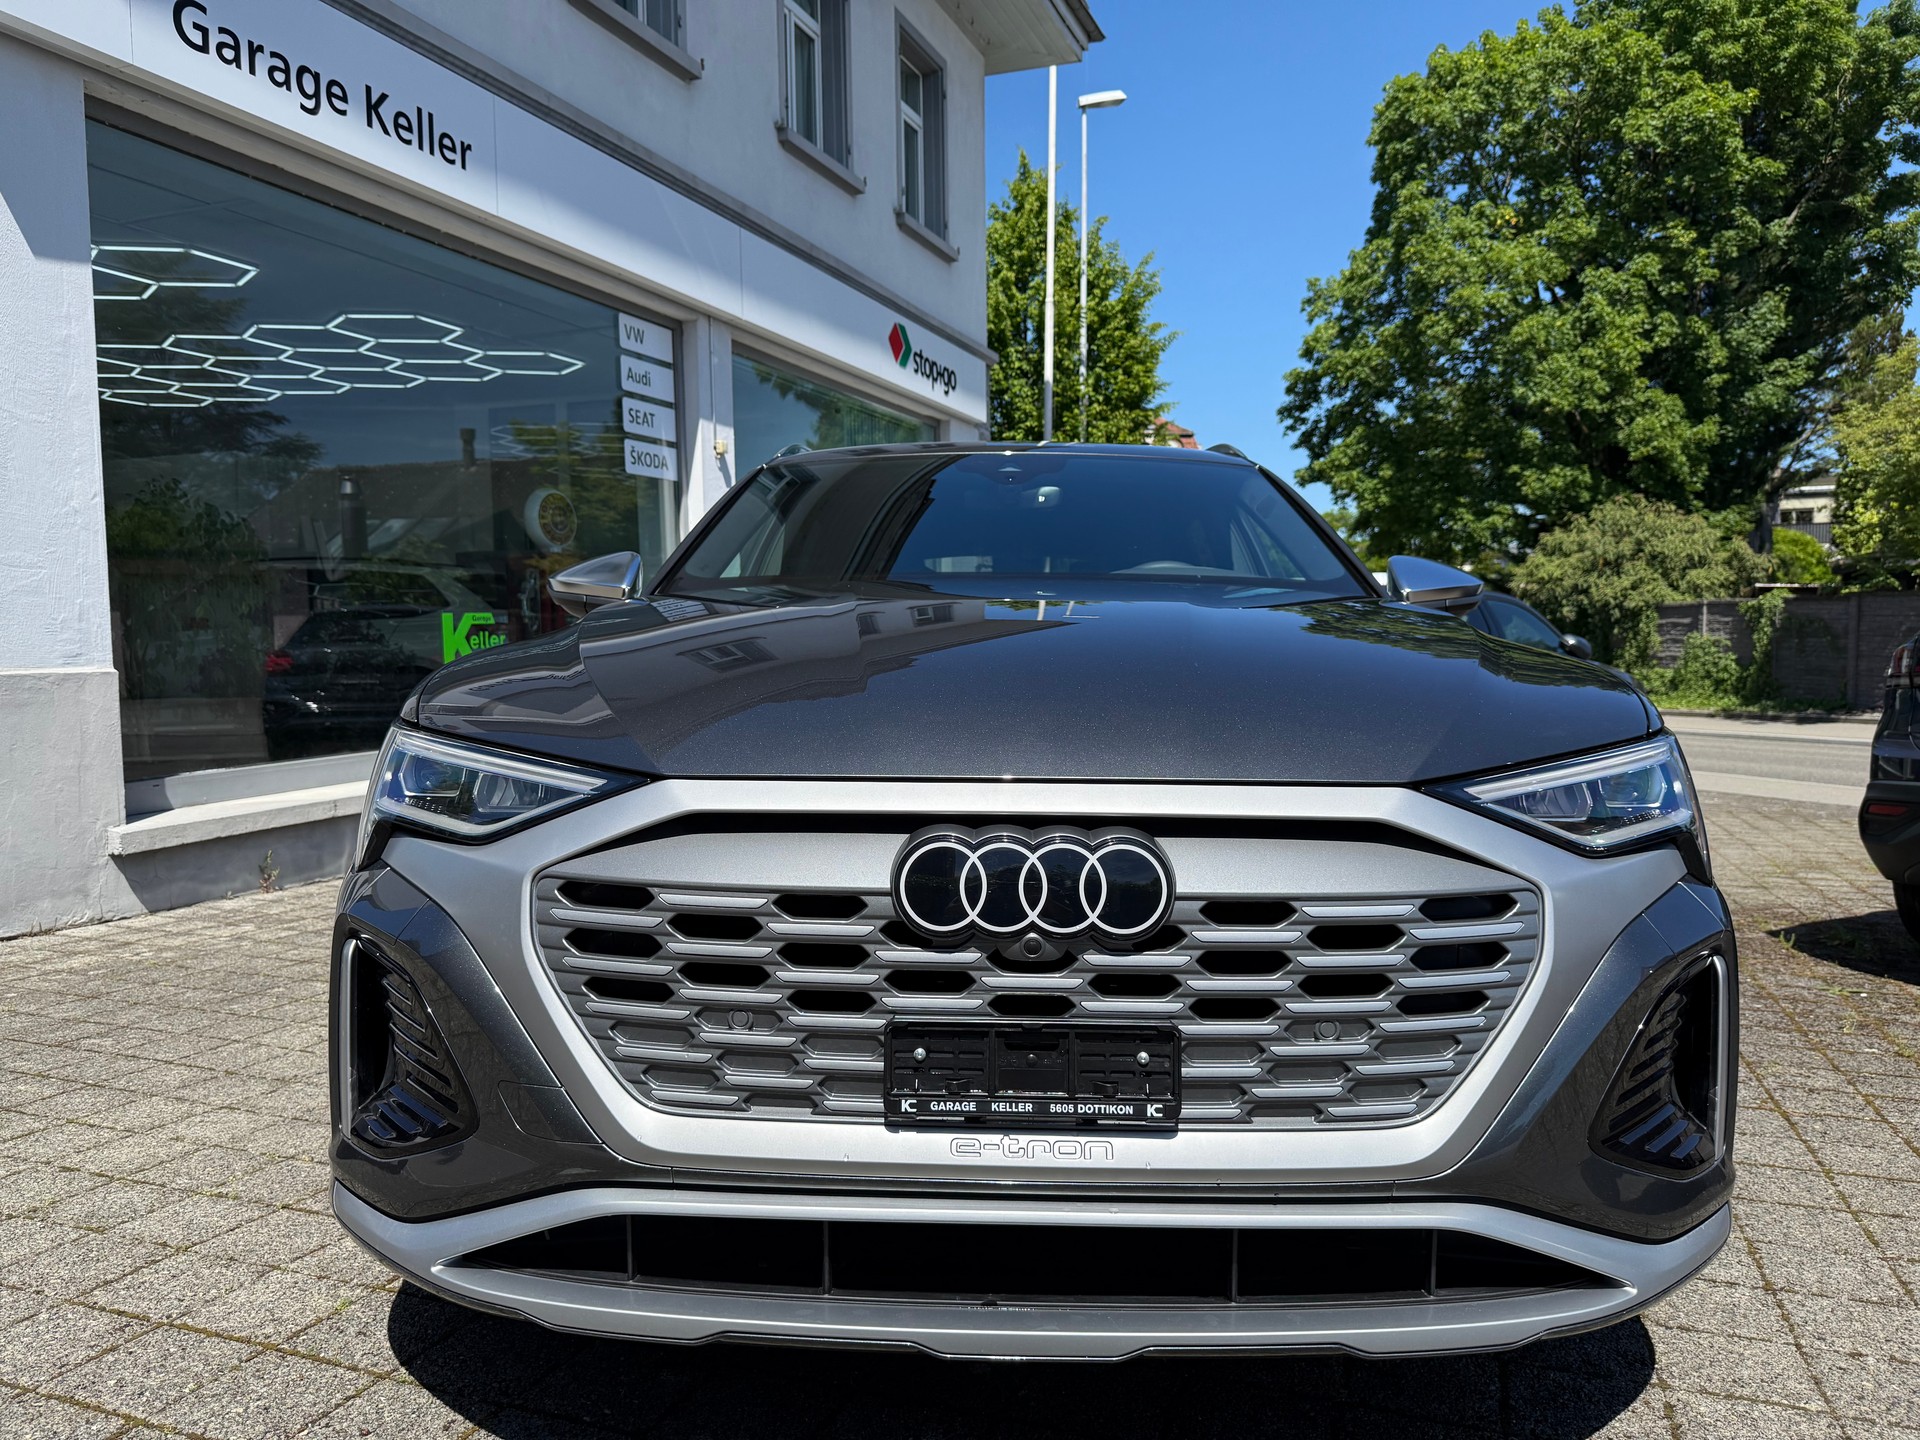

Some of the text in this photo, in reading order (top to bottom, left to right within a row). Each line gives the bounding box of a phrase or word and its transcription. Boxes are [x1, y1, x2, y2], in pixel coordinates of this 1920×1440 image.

[172, 0, 473, 171] Garage Keller
[624, 323, 645, 345] VW
[626, 367, 652, 388] Audi
[913, 349, 957, 397] stop+go
[628, 407, 656, 429] SEAT
[630, 445, 669, 471] ŠKODA
[441, 611, 507, 665] Keller
[930, 1101, 977, 1112] GARAGE
[991, 1102, 1033, 1112] KELLER
[1049, 1103, 1075, 1114] 5605
[1077, 1104, 1134, 1115] DOTTIKON
[949, 1134, 1115, 1161] e-tron
